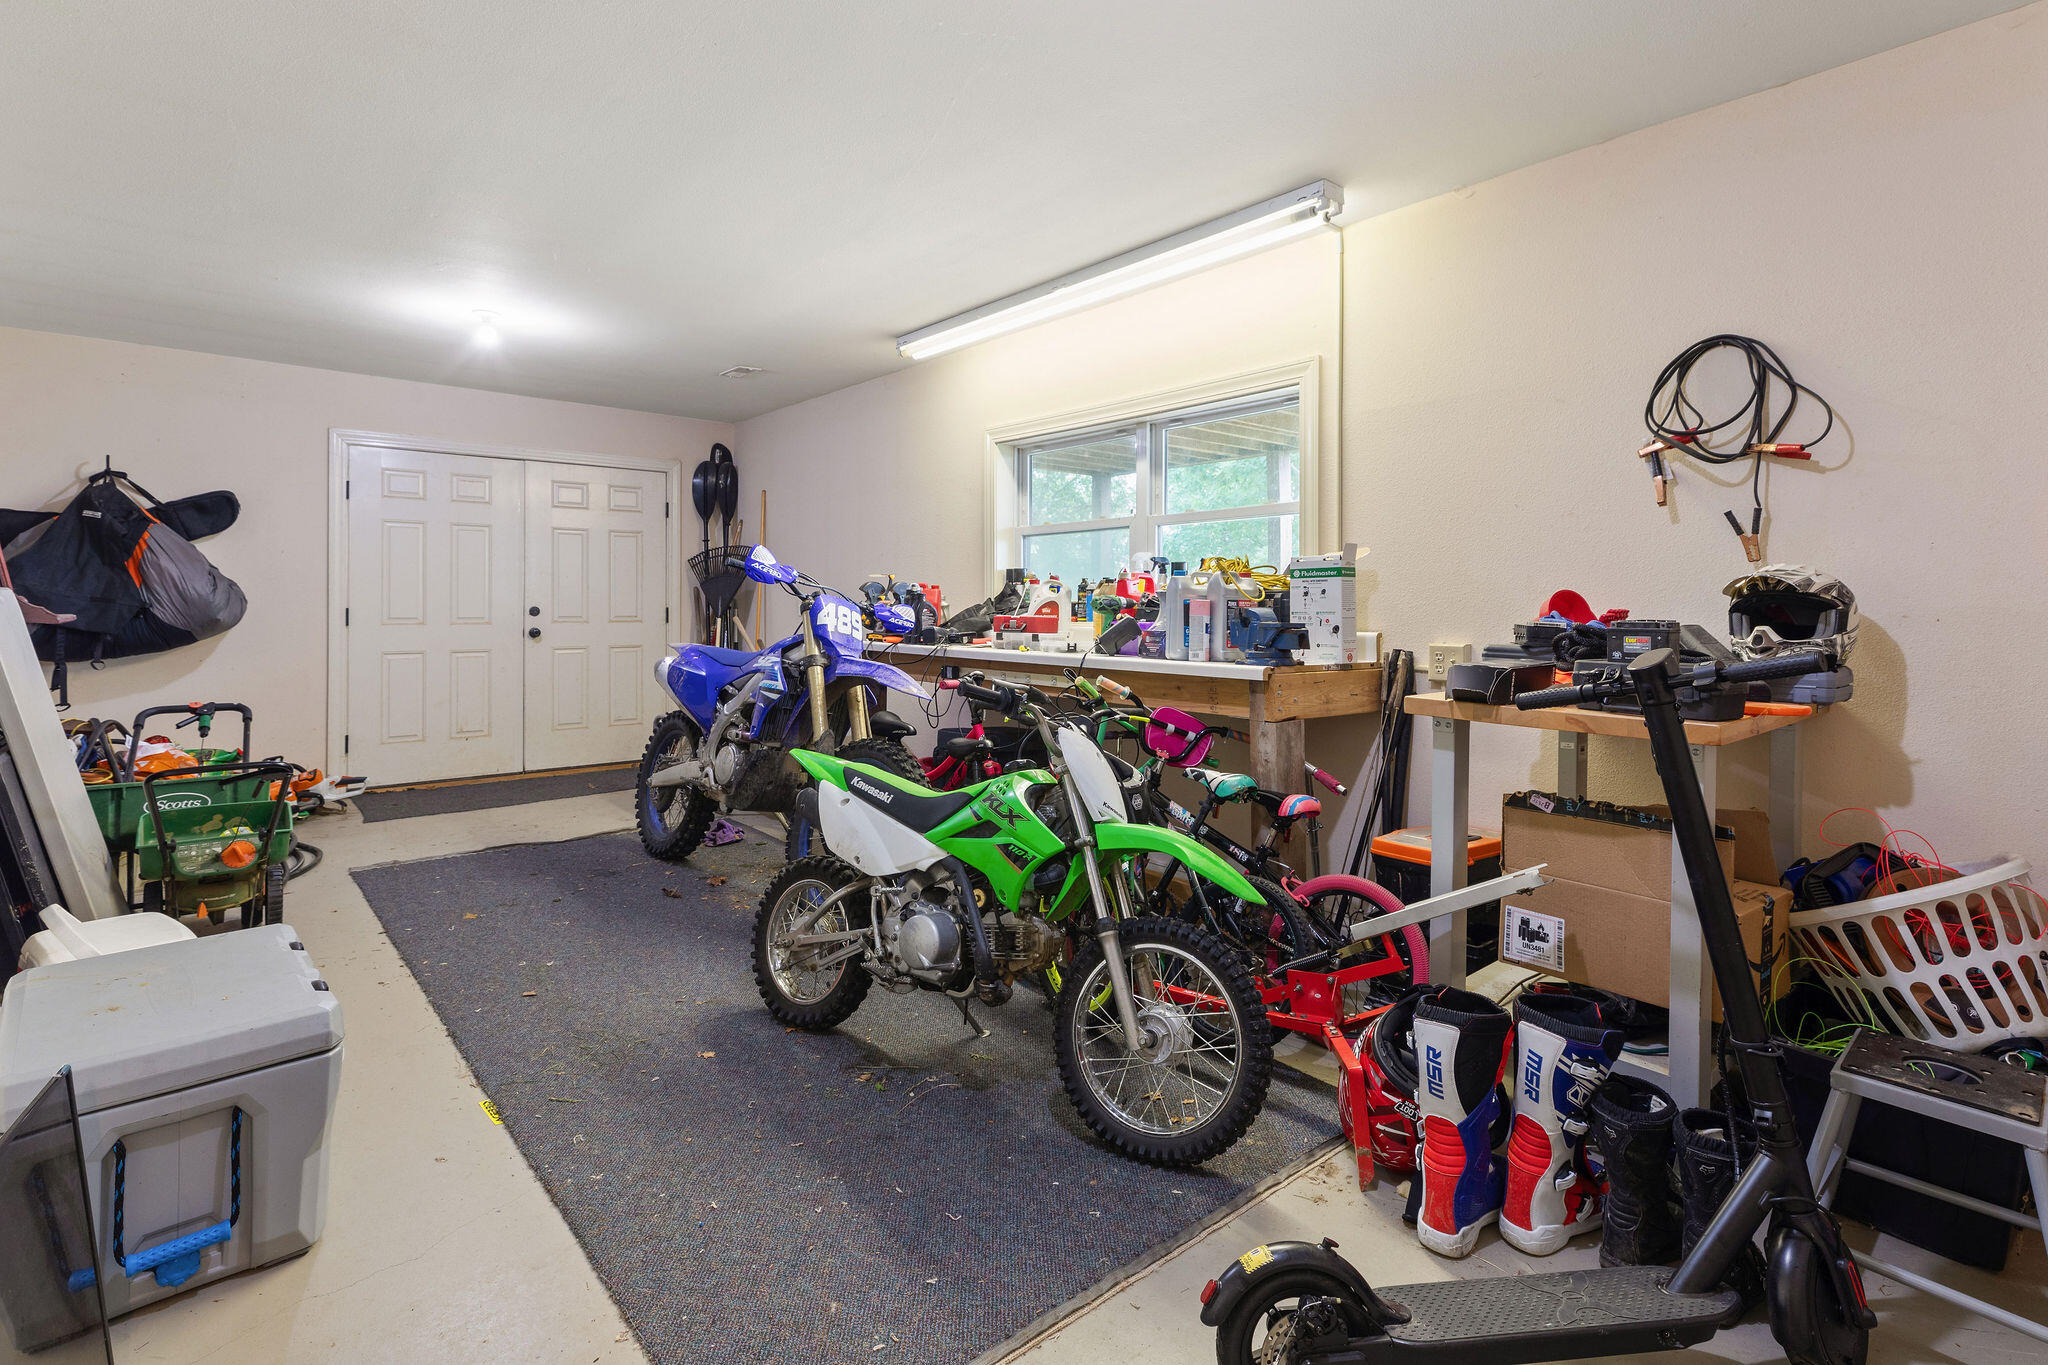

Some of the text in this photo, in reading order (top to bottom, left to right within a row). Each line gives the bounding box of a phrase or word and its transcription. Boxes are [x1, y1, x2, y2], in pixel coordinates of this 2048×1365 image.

[816, 602, 863, 641] 489
[157, 799, 202, 811] Scotts
[850, 776, 894, 804] Kawasaki
[980, 791, 1031, 831] KLX
[1522, 942, 1545, 954] UN3481
[1426, 1044, 1445, 1101] MSR
[1524, 1048, 1544, 1105] MSR
